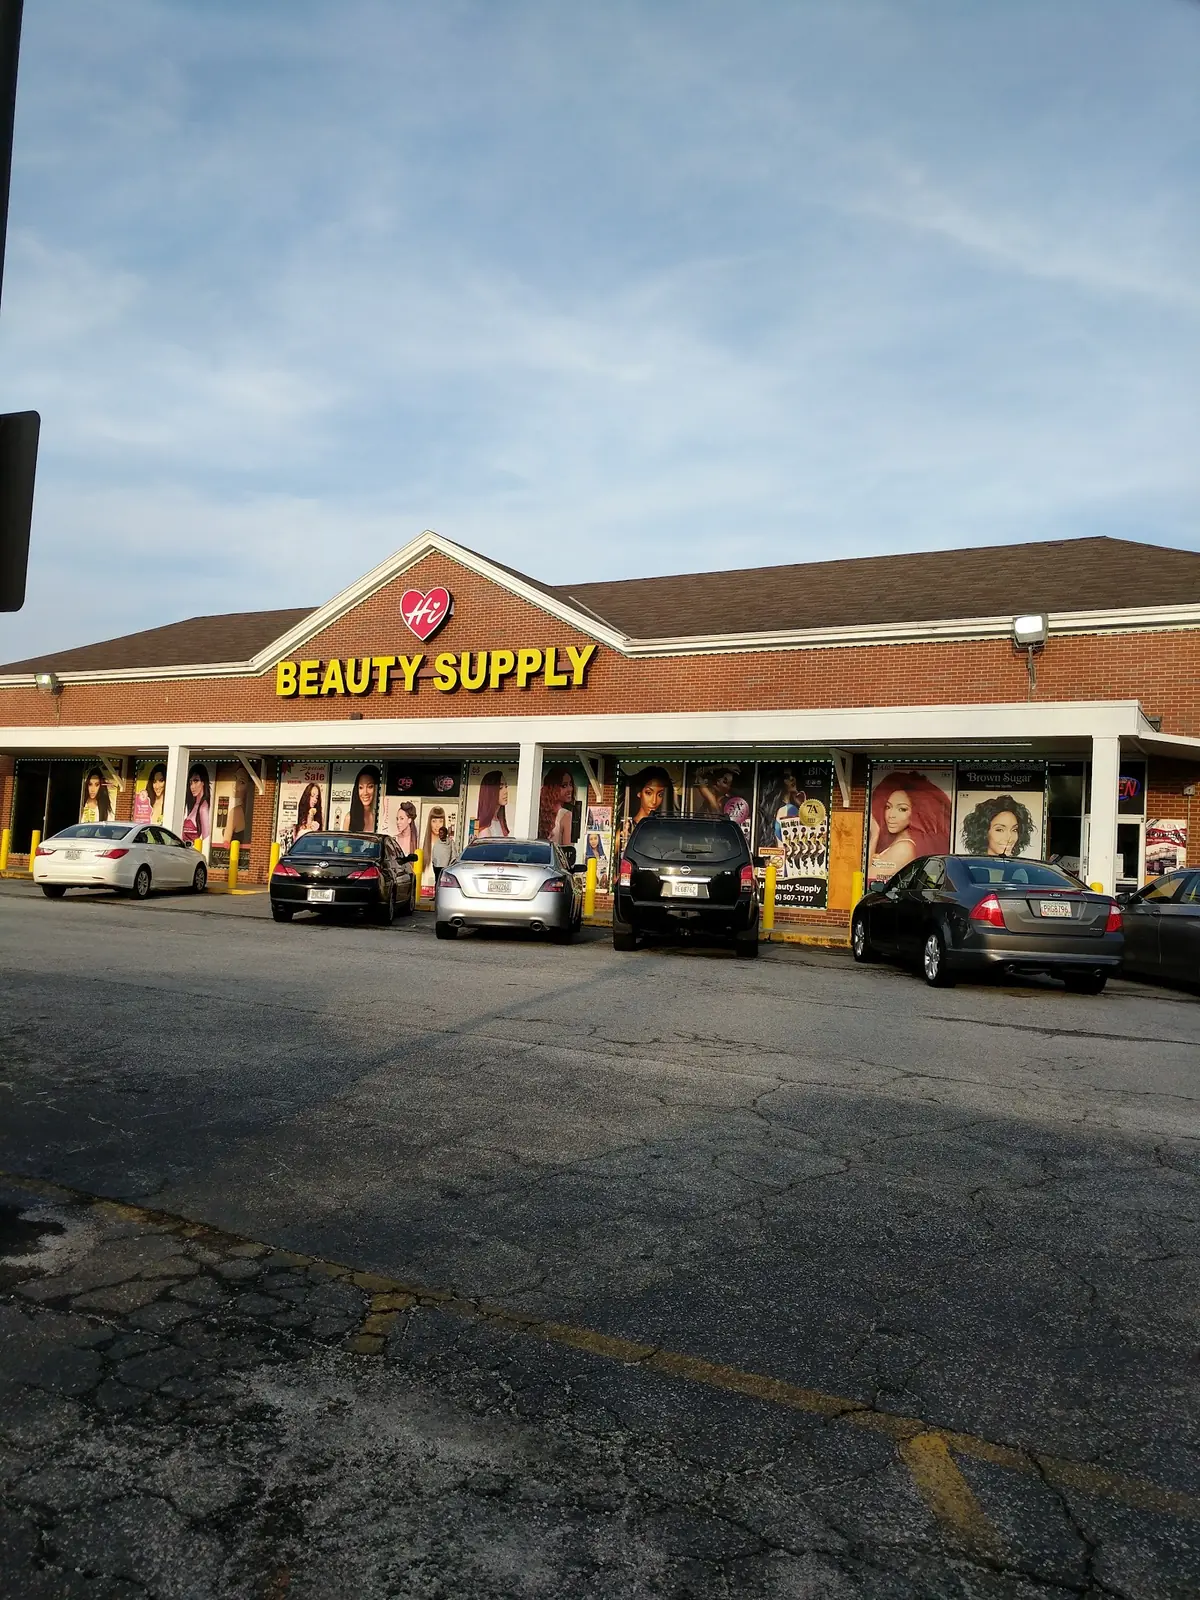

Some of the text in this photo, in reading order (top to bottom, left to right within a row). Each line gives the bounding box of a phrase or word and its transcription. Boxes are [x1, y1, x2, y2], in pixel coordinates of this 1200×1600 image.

[405, 597, 445, 626] Hi
[275, 644, 597, 696] BEAUTY SUPPLY
[304, 771, 325, 781] Sale
[966, 772, 1032, 785] Brown Sugar
[775, 884, 794, 893] eauty
[795, 884, 822, 894] Supply
[783, 894, 814, 903] 507-1717
